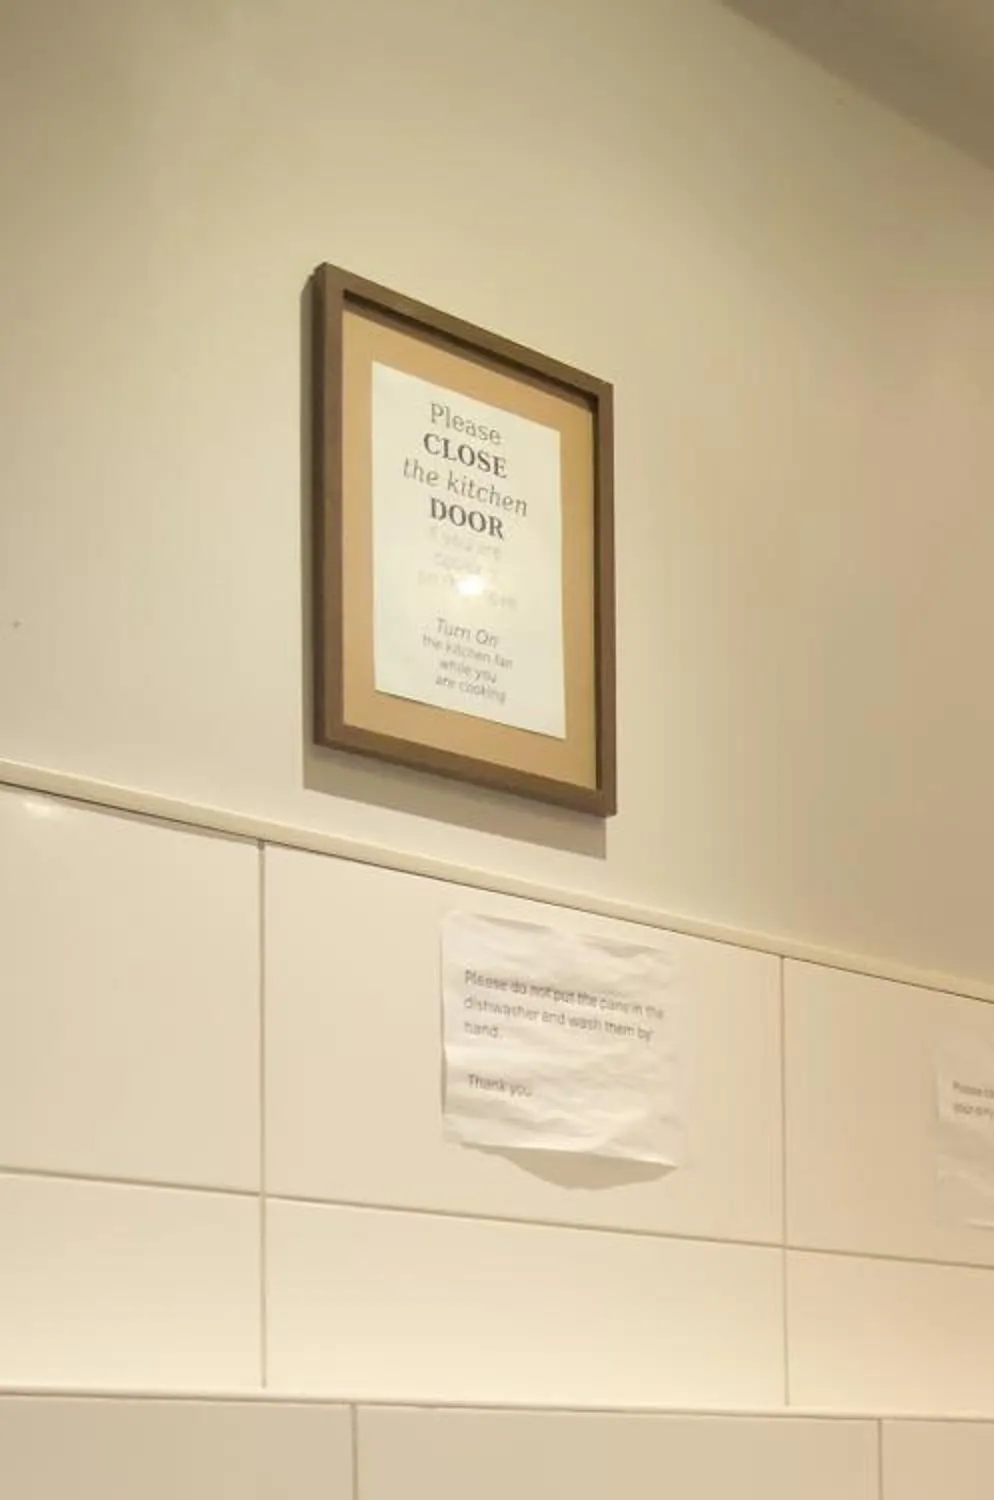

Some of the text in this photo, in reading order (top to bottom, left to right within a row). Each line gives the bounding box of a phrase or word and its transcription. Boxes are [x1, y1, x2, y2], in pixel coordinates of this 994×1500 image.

[431, 402, 501, 445] Please
[423, 432, 507, 479] CLOSE
[403, 457, 528, 517] the kitchen
[430, 498, 504, 541] DOOR
[437, 617, 499, 648] Turn On
[464, 969, 508, 992] Please
[511, 979, 527, 994] do
[463, 995, 540, 1021] dishwasher
[541, 1009, 566, 1026] and
[568, 1016, 602, 1032] wash
[467, 1073, 506, 1092] Thank
